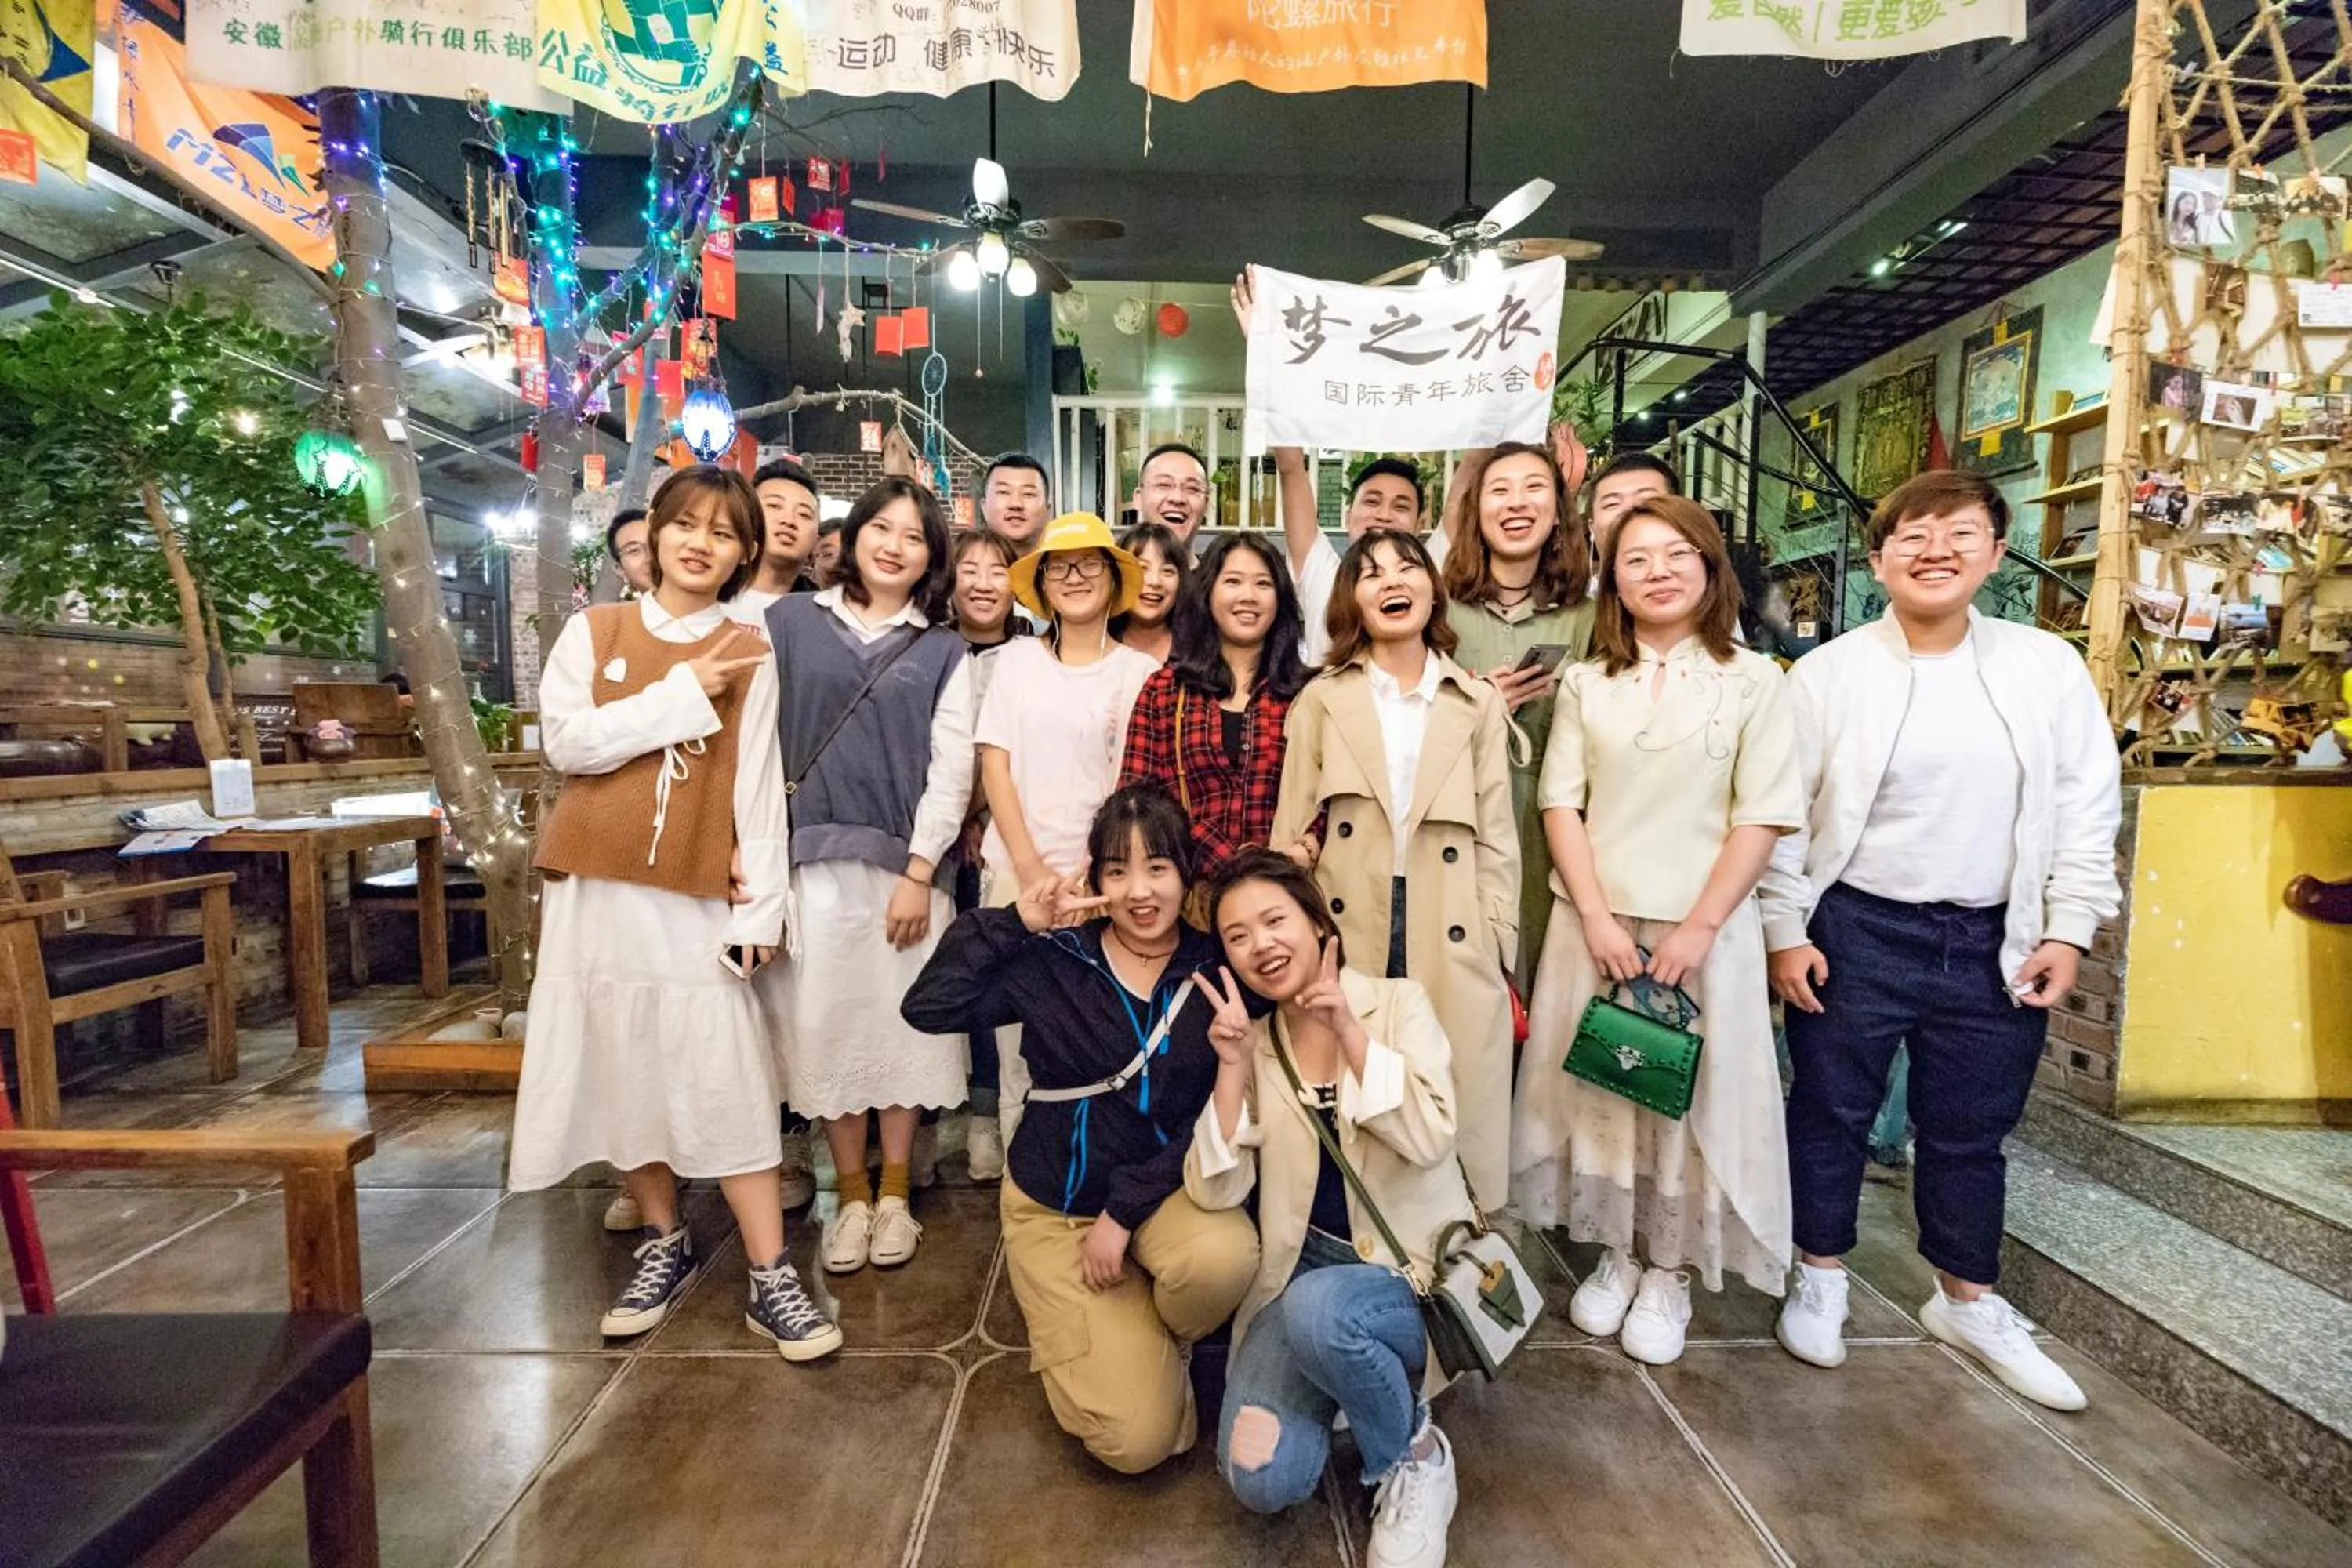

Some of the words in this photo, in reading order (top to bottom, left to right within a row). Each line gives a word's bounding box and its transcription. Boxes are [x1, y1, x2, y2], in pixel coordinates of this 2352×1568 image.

[837, 32, 897, 70] 运动
[923, 27, 973, 71] 健康
[996, 27, 1055, 78] 快乐
[1280, 293, 1542, 365] 梦之旅
[1323, 364, 1531, 408] 国际青年旅舍
